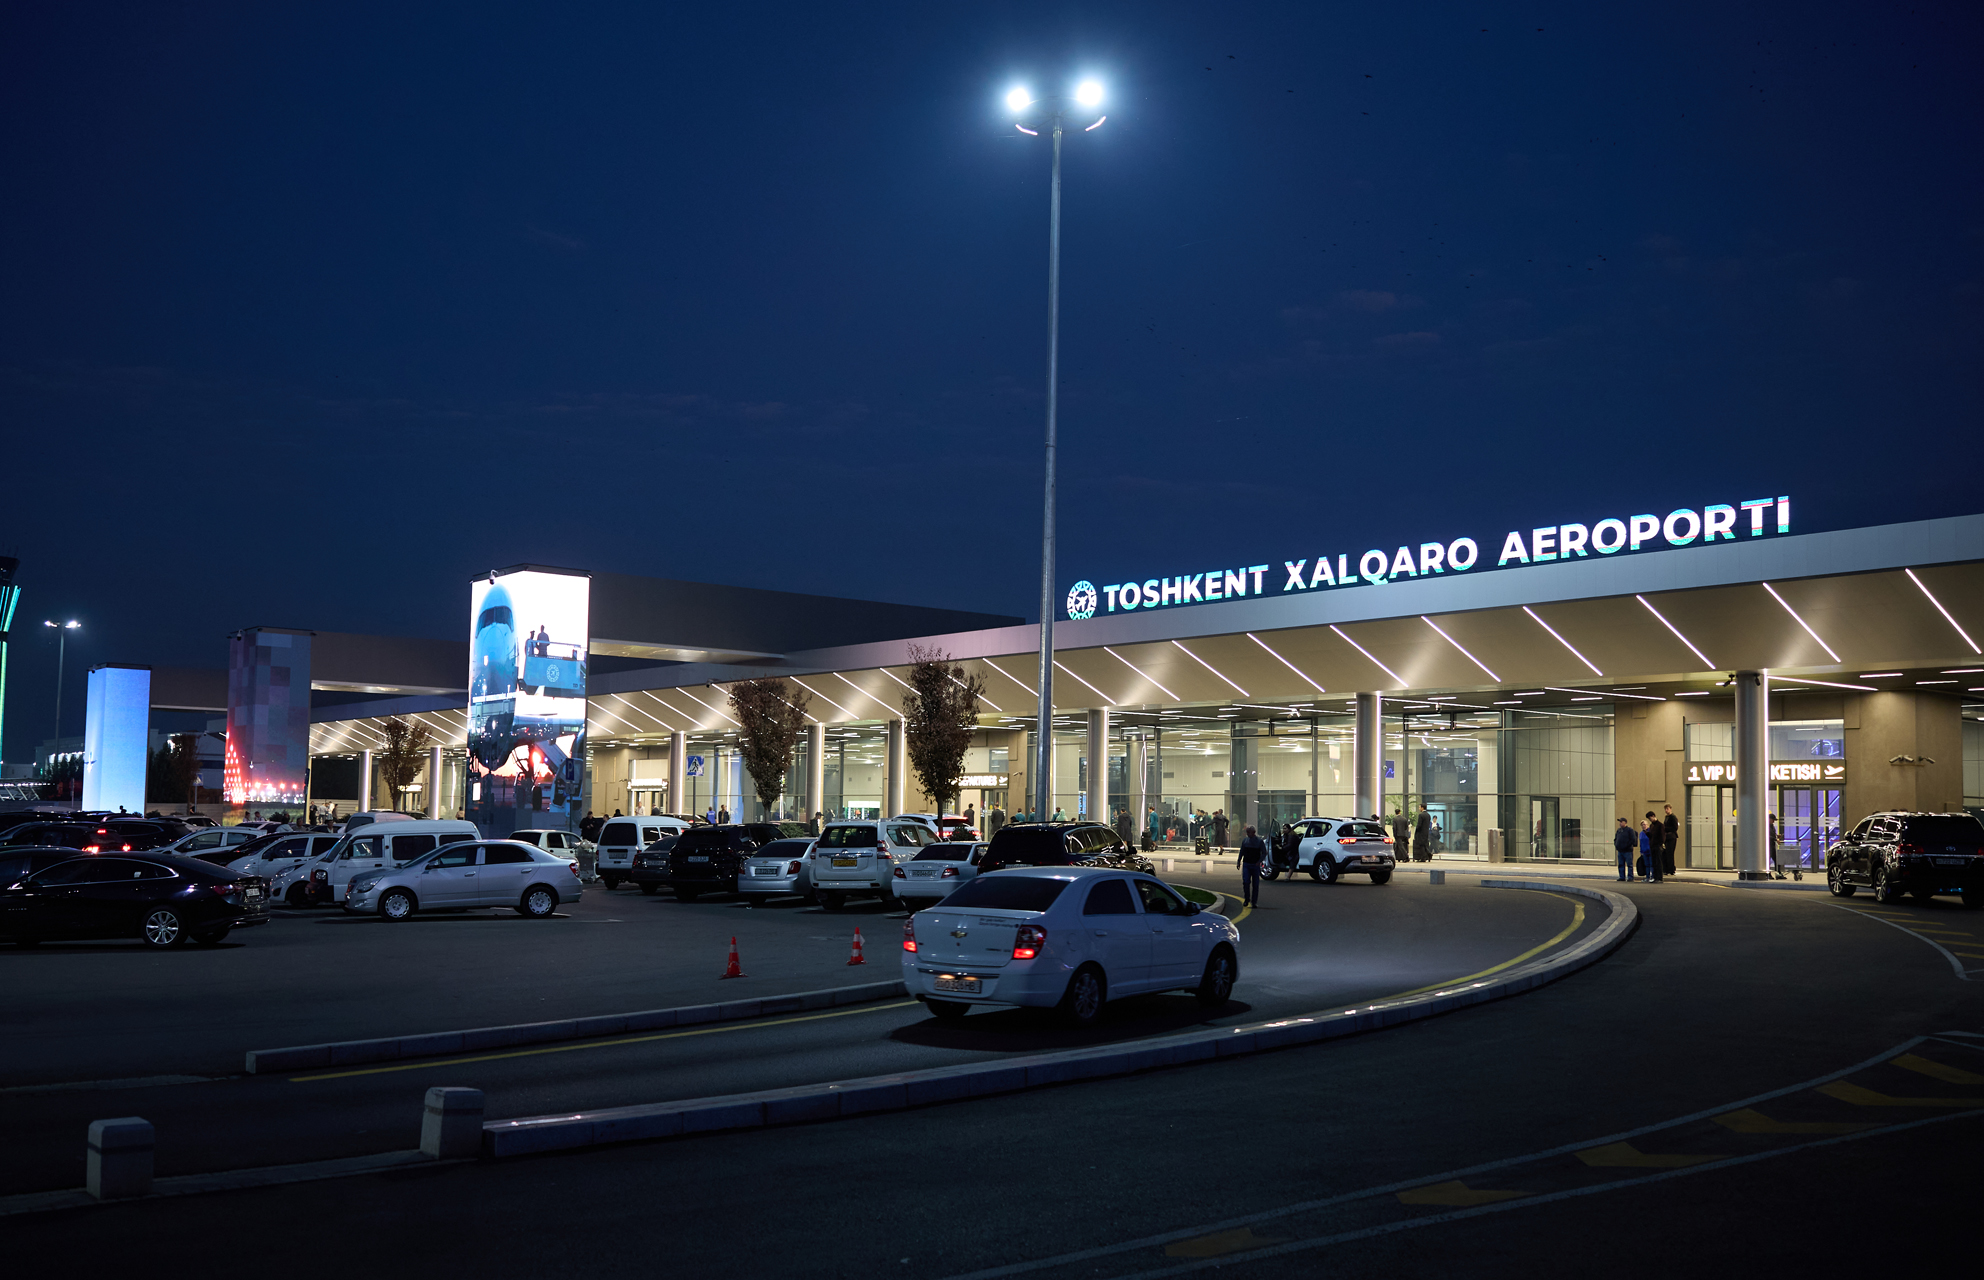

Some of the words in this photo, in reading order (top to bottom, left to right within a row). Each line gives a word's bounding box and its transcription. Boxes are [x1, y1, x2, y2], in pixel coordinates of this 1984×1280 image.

[1102, 565, 1269, 612] TOSHKENT
[1284, 537, 1478, 590] XALQARO
[1498, 496, 1790, 567] AEROPORTI
[1702, 765, 1724, 781] VIP
[1770, 764, 1821, 781] KETISH
